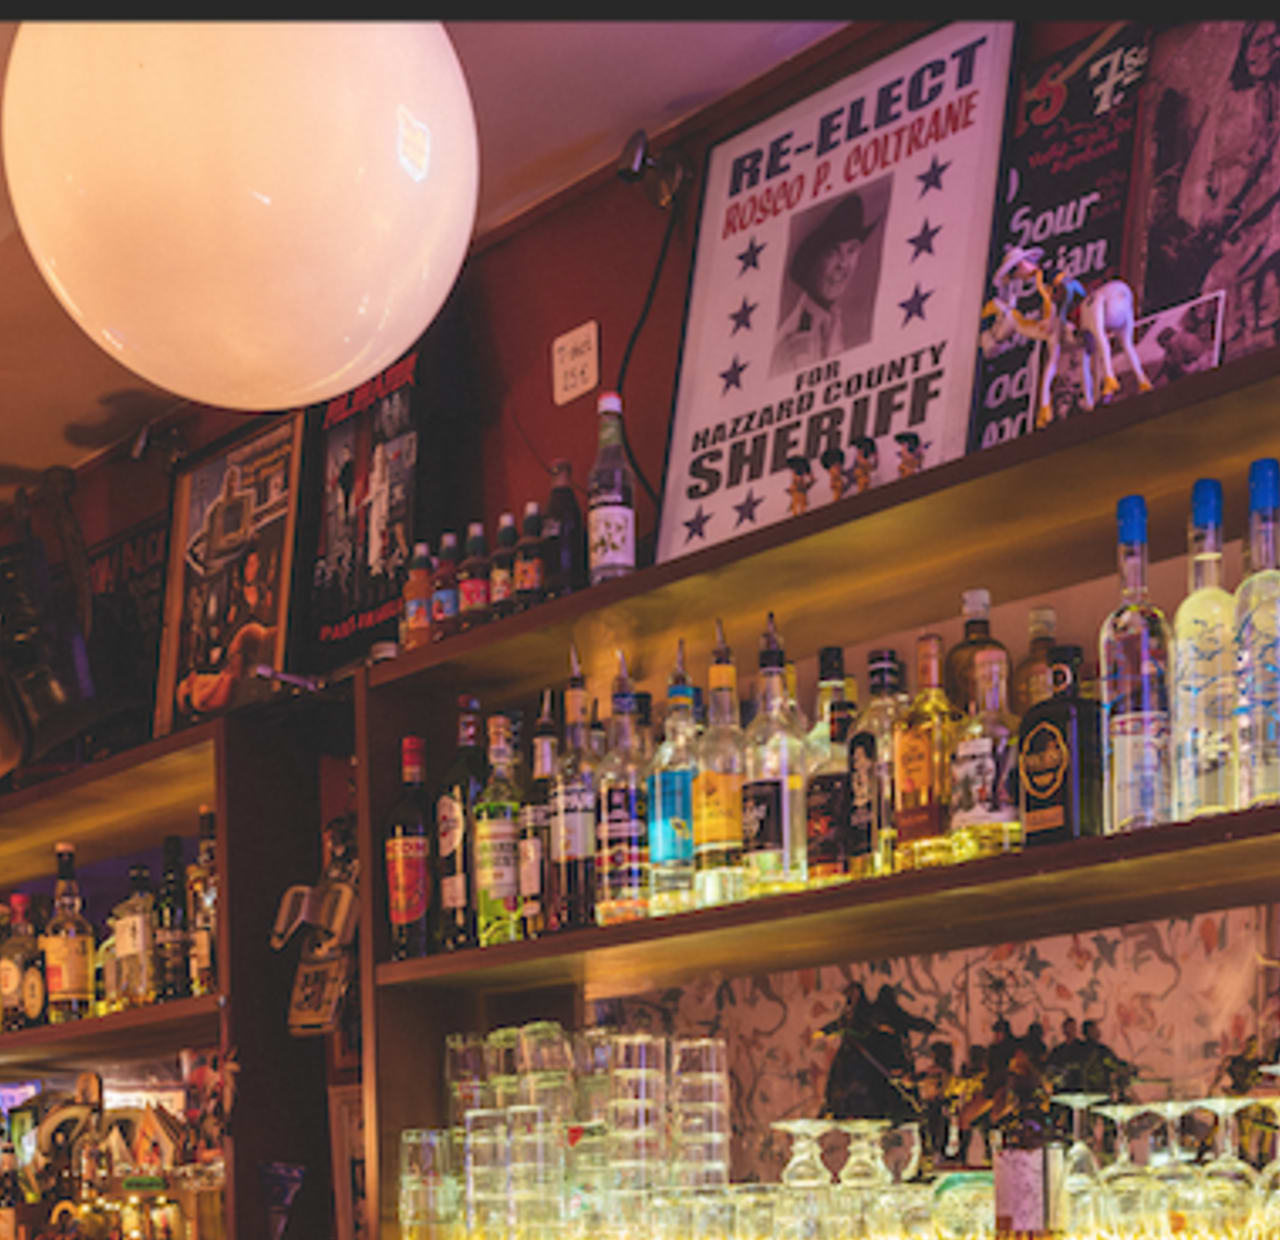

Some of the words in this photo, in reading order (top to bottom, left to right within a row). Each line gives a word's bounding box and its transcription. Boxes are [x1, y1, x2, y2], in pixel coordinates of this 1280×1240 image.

[722, 174, 806, 240] ROSCO
[811, 160, 832, 197] P.
[842, 90, 980, 184] COLTRANE
[728, 36, 988, 198] RE-ELECT
[1009, 191, 1101, 246] Sour
[685, 368, 945, 500] SHERIFF
[690, 389, 816, 452] HAZZARD
[822, 340, 949, 406] COUNTY
[794, 360, 841, 392] FOR
